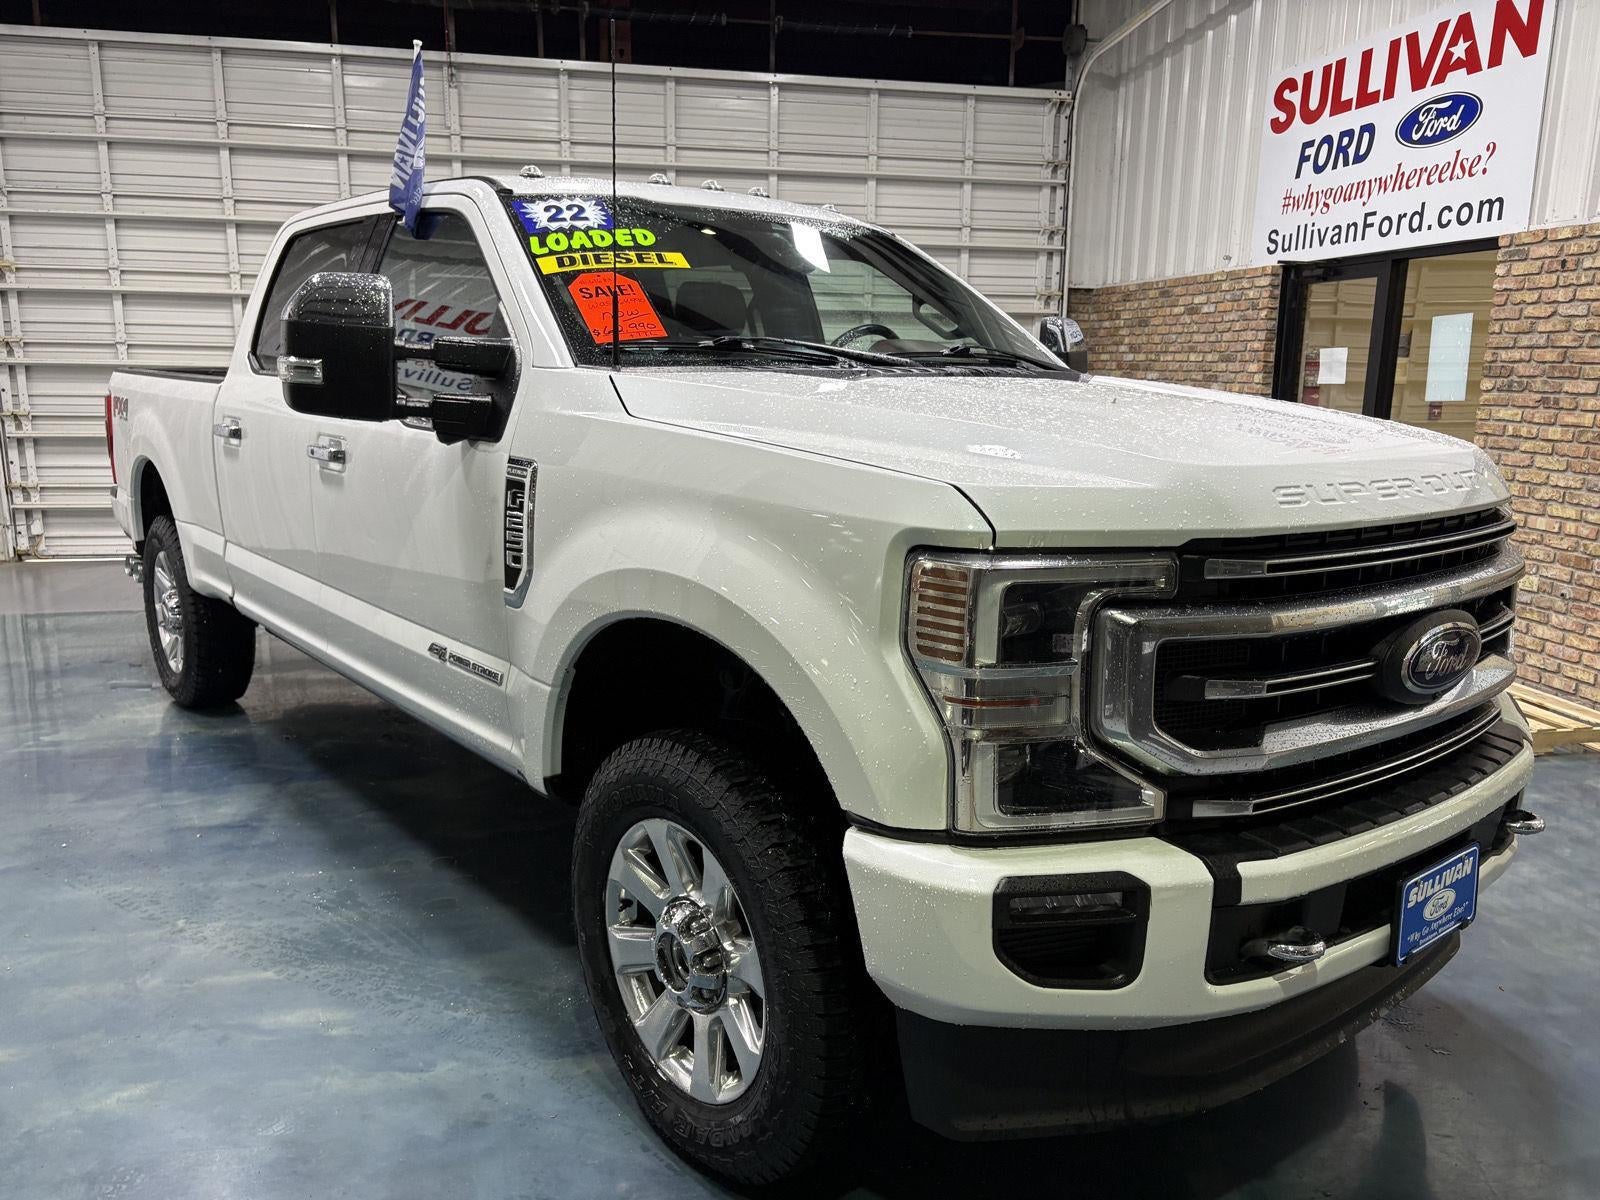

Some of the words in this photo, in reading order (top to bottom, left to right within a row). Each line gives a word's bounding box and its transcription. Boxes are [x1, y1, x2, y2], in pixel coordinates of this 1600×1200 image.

[1270, 0, 1544, 135] SULLIVAN
[1412, 99, 1467, 141] Ford
[1295, 123, 1376, 179] FORD
[1281, 141, 1497, 217] #whygoanywhereelse?
[543, 203, 590, 223] 22
[1267, 196, 1505, 256] SullivanFord.com
[529, 228, 656, 255] LOADED
[555, 251, 677, 269] DIESEL
[578, 283, 637, 300] SALE!
[1272, 477, 1426, 508] SUPER
[449, 652, 471, 669] POWER
[471, 662, 500, 681] STROKE
[1425, 638, 1470, 680] Ford
[1407, 856, 1474, 909] SULLIVAN
[1429, 895, 1450, 917] Ford
